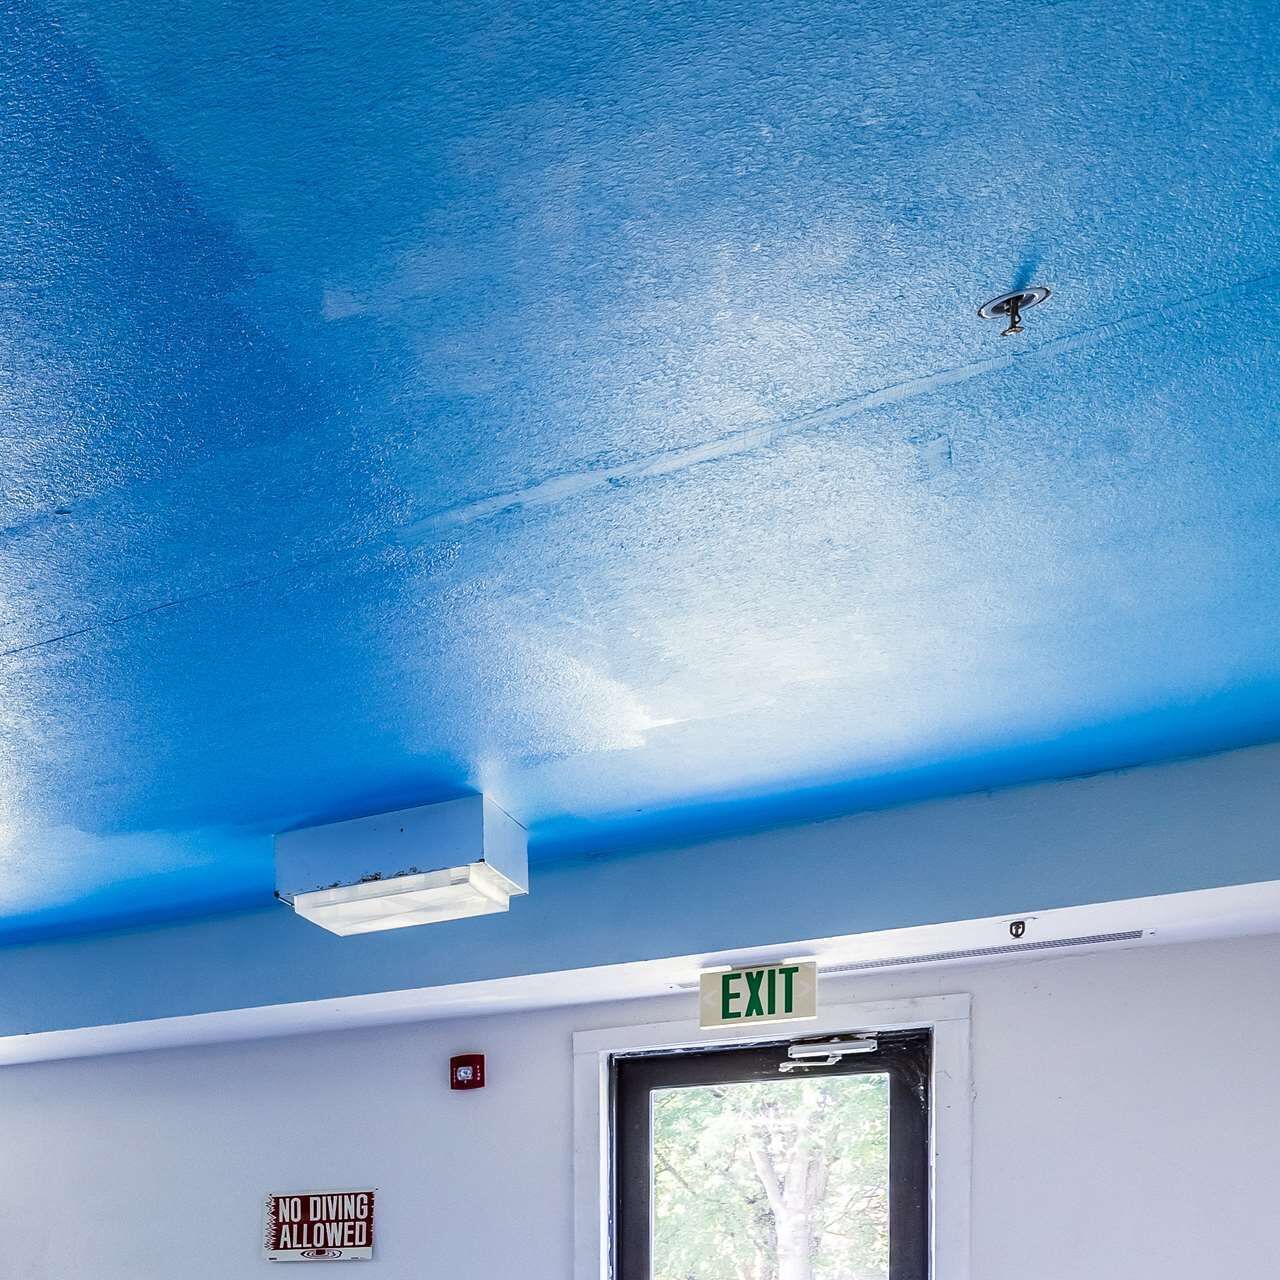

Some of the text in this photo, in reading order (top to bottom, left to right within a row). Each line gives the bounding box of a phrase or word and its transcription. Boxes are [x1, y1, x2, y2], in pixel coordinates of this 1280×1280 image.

[721, 966, 799, 1020] EXIT
[278, 1193, 369, 1223] NO DIVING
[279, 1221, 368, 1249] ALLOWED
